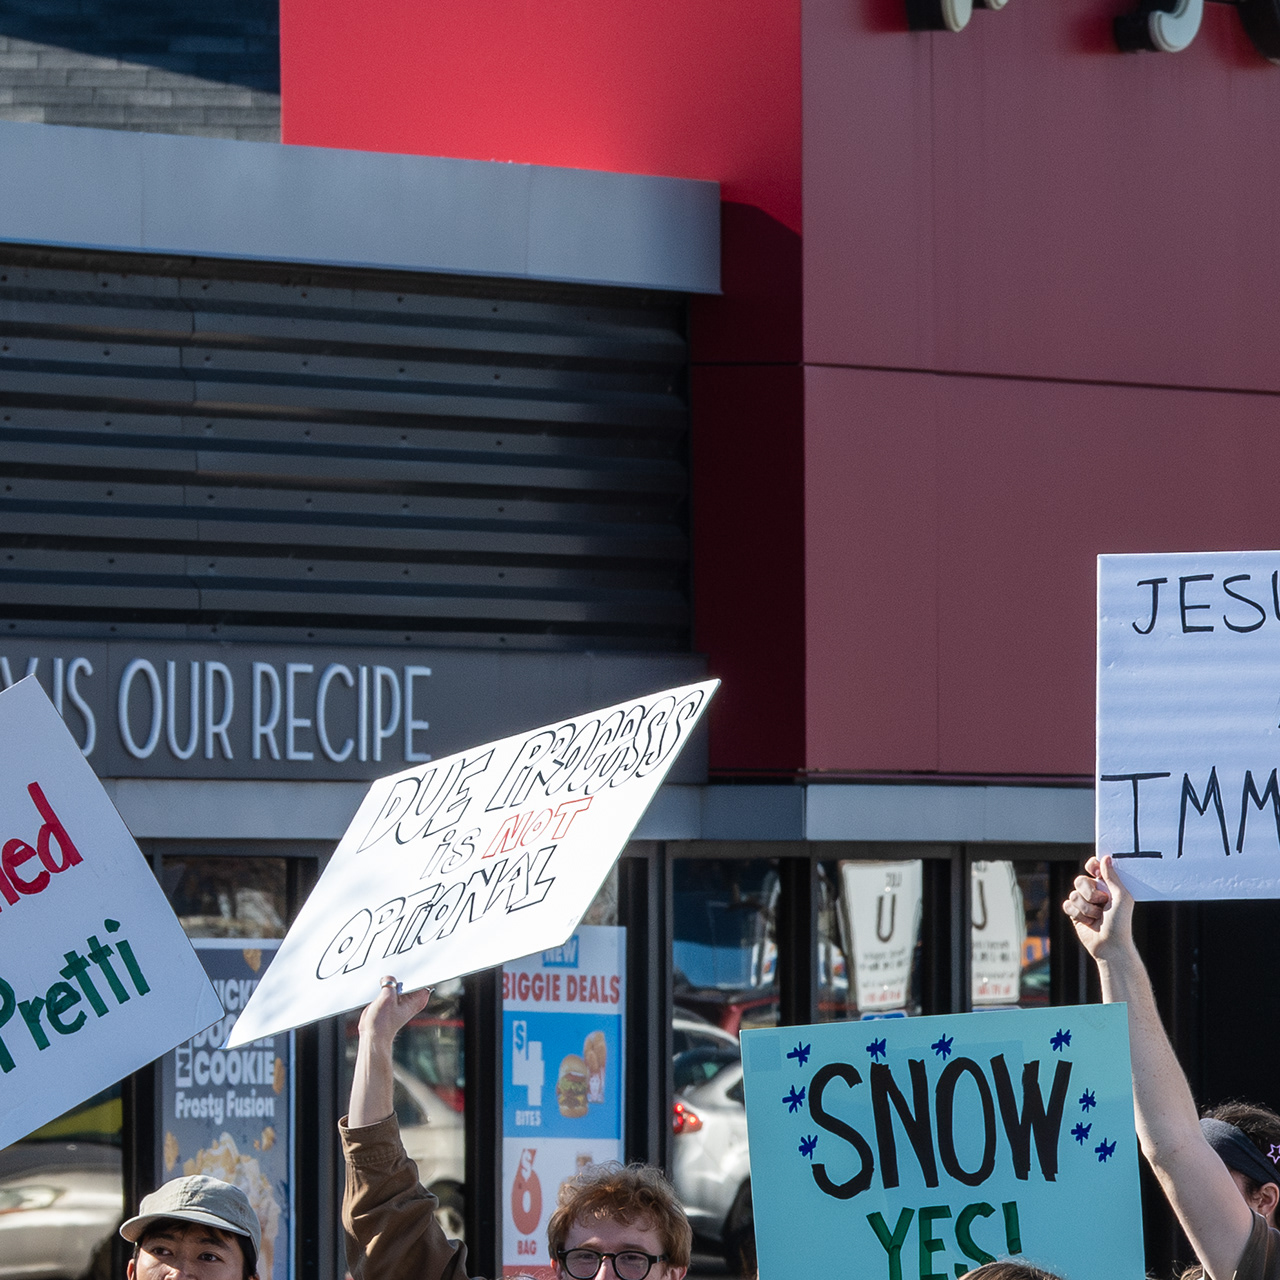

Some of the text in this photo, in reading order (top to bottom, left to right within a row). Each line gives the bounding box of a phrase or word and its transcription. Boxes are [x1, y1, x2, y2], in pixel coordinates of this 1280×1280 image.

[118, 658, 234, 761] OUR
[252, 661, 432, 763] RECIPE
[356, 690, 704, 854] DUE PROCESS
[482, 796, 594, 860] NOT
[503, 971, 621, 1004] BIGGIE DEALS
[193, 1050, 275, 1086] COOKIE
[175, 1090, 275, 1125] Frosty Fusion
[516, 1110, 541, 1127] BITES
[808, 1053, 1073, 1199] SNOW
[517, 1240, 537, 1256] BAG
